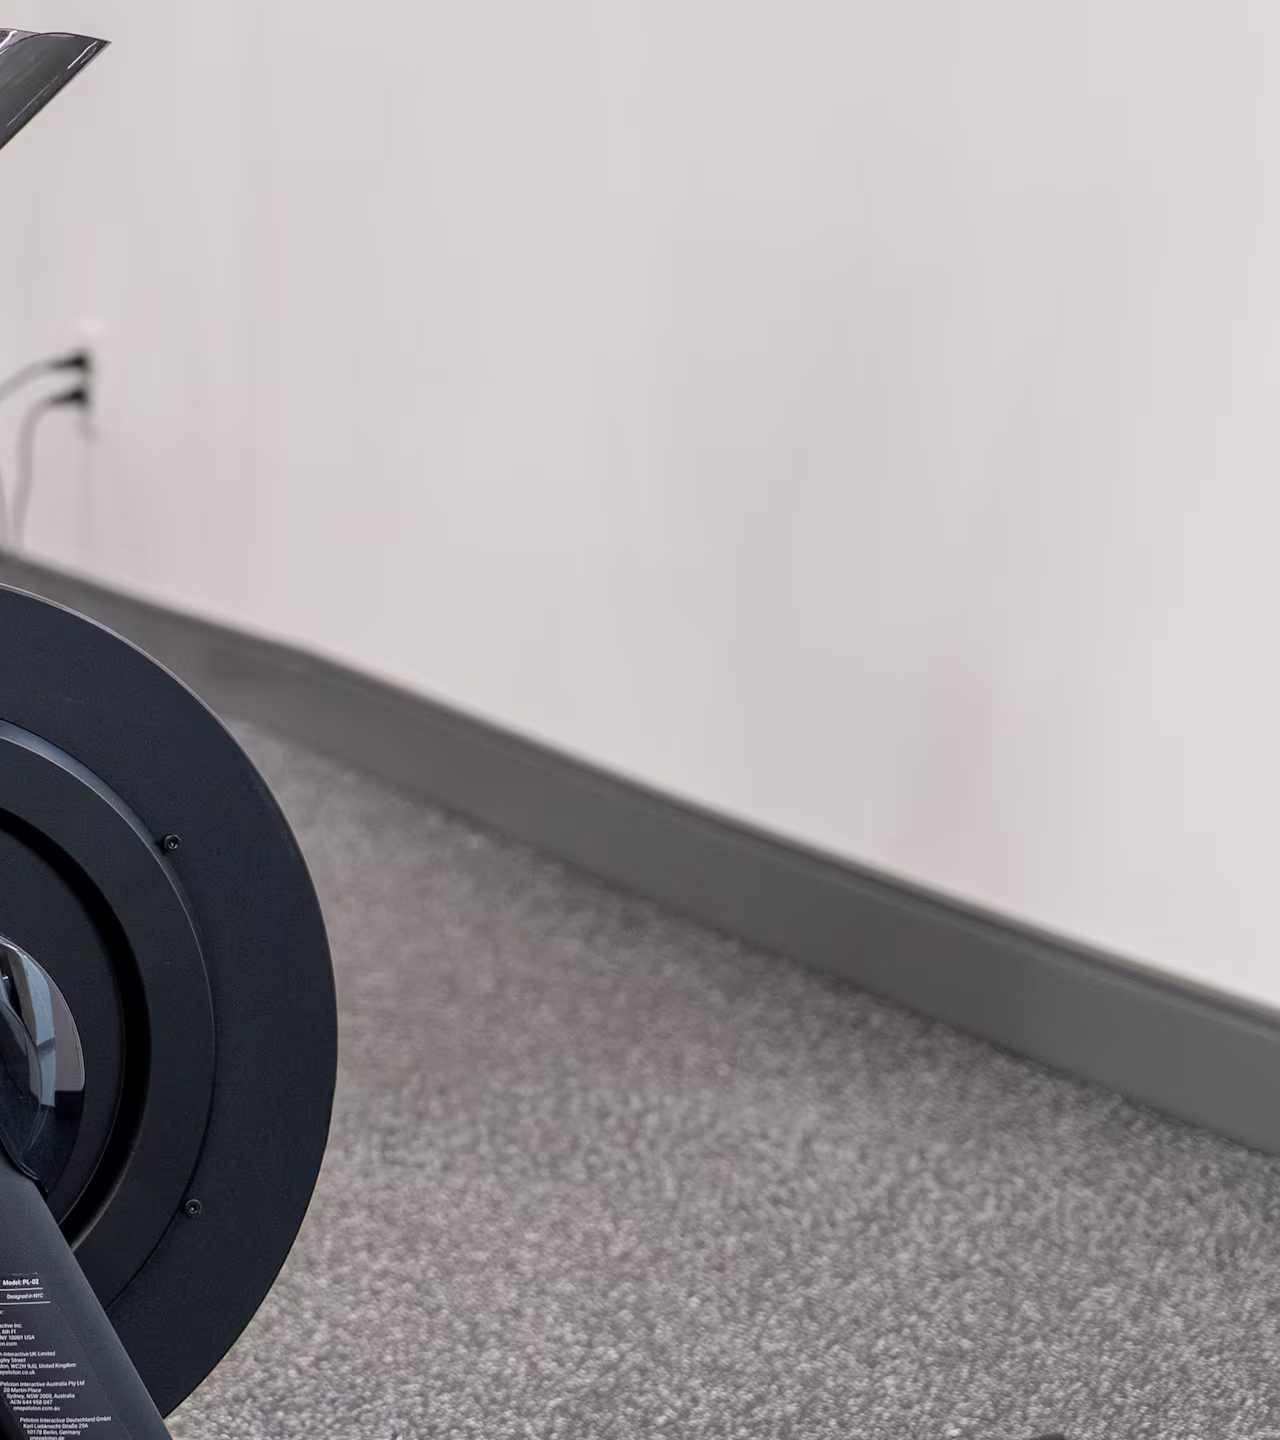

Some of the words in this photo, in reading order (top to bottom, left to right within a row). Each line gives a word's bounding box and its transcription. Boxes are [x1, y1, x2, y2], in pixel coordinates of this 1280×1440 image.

[2, 1278, 22, 1286] Model:
[22, 1278, 39, 1286] PL-02
[6, 1293, 28, 1301] Designed
[54, 1362, 76, 1370] Kingdom
